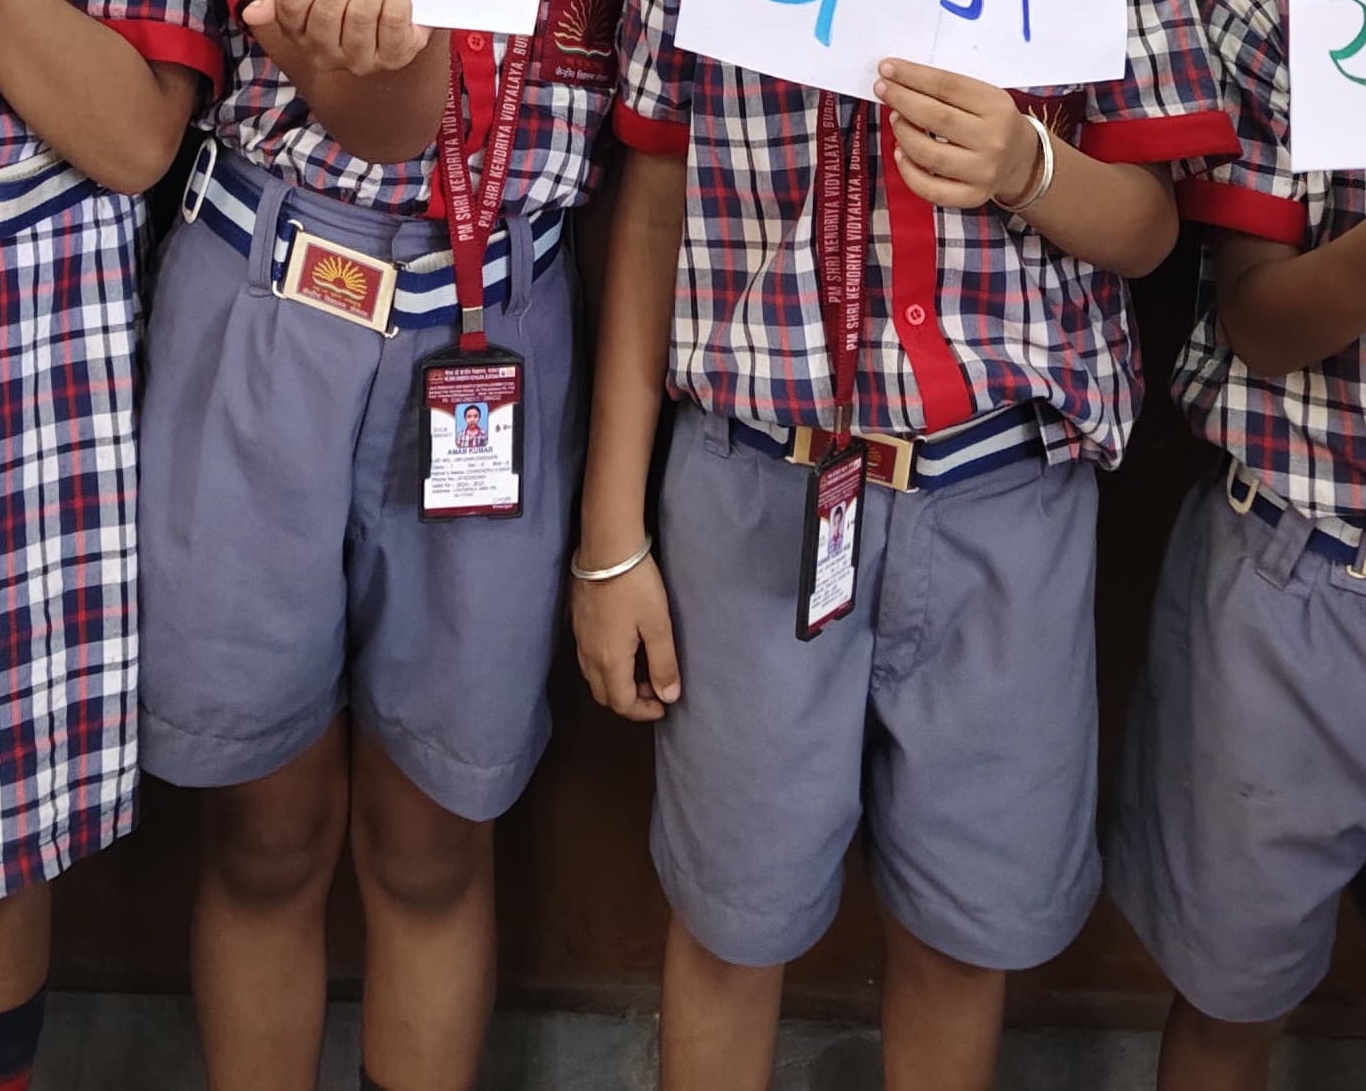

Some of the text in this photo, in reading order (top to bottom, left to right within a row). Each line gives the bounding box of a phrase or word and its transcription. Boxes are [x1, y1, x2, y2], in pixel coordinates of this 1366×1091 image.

[444, 137, 468, 193] KENDRIYA
[488, 124, 513, 179] KENDRIYA
[452, 193, 472, 220] SHRI
[482, 179, 501, 208] SHRI
[458, 223, 475, 241] PM
[478, 209, 495, 228] PM
[824, 201, 841, 253] KENDRIYA
[825, 255, 841, 283] SHRI
[846, 245, 863, 300] KENDRIYA
[846, 303, 860, 330] SHRI
[846, 332, 859, 351] PM
